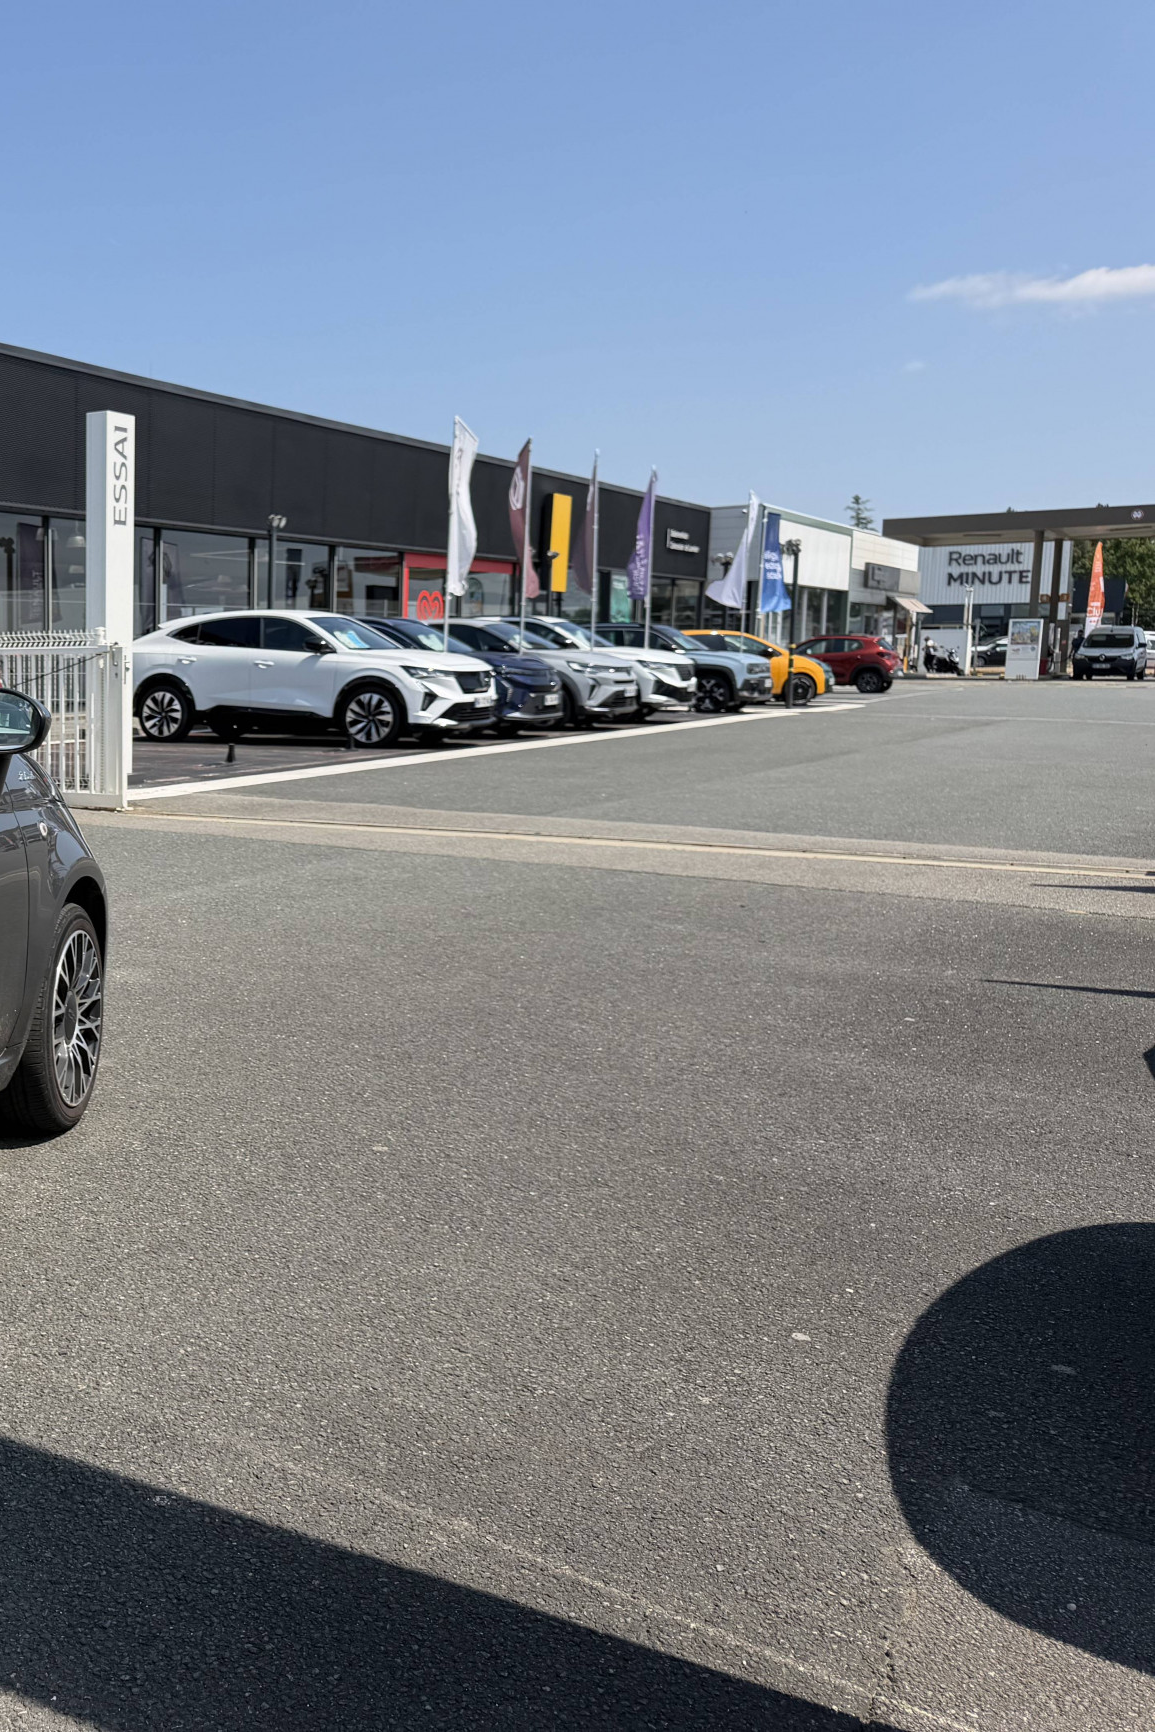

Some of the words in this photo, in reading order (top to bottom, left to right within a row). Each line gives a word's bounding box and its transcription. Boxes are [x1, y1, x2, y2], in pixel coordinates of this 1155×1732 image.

[113, 425, 128, 527] ESSAI
[948, 548, 1024, 567] Renault
[947, 569, 1031, 587] MINUTE
